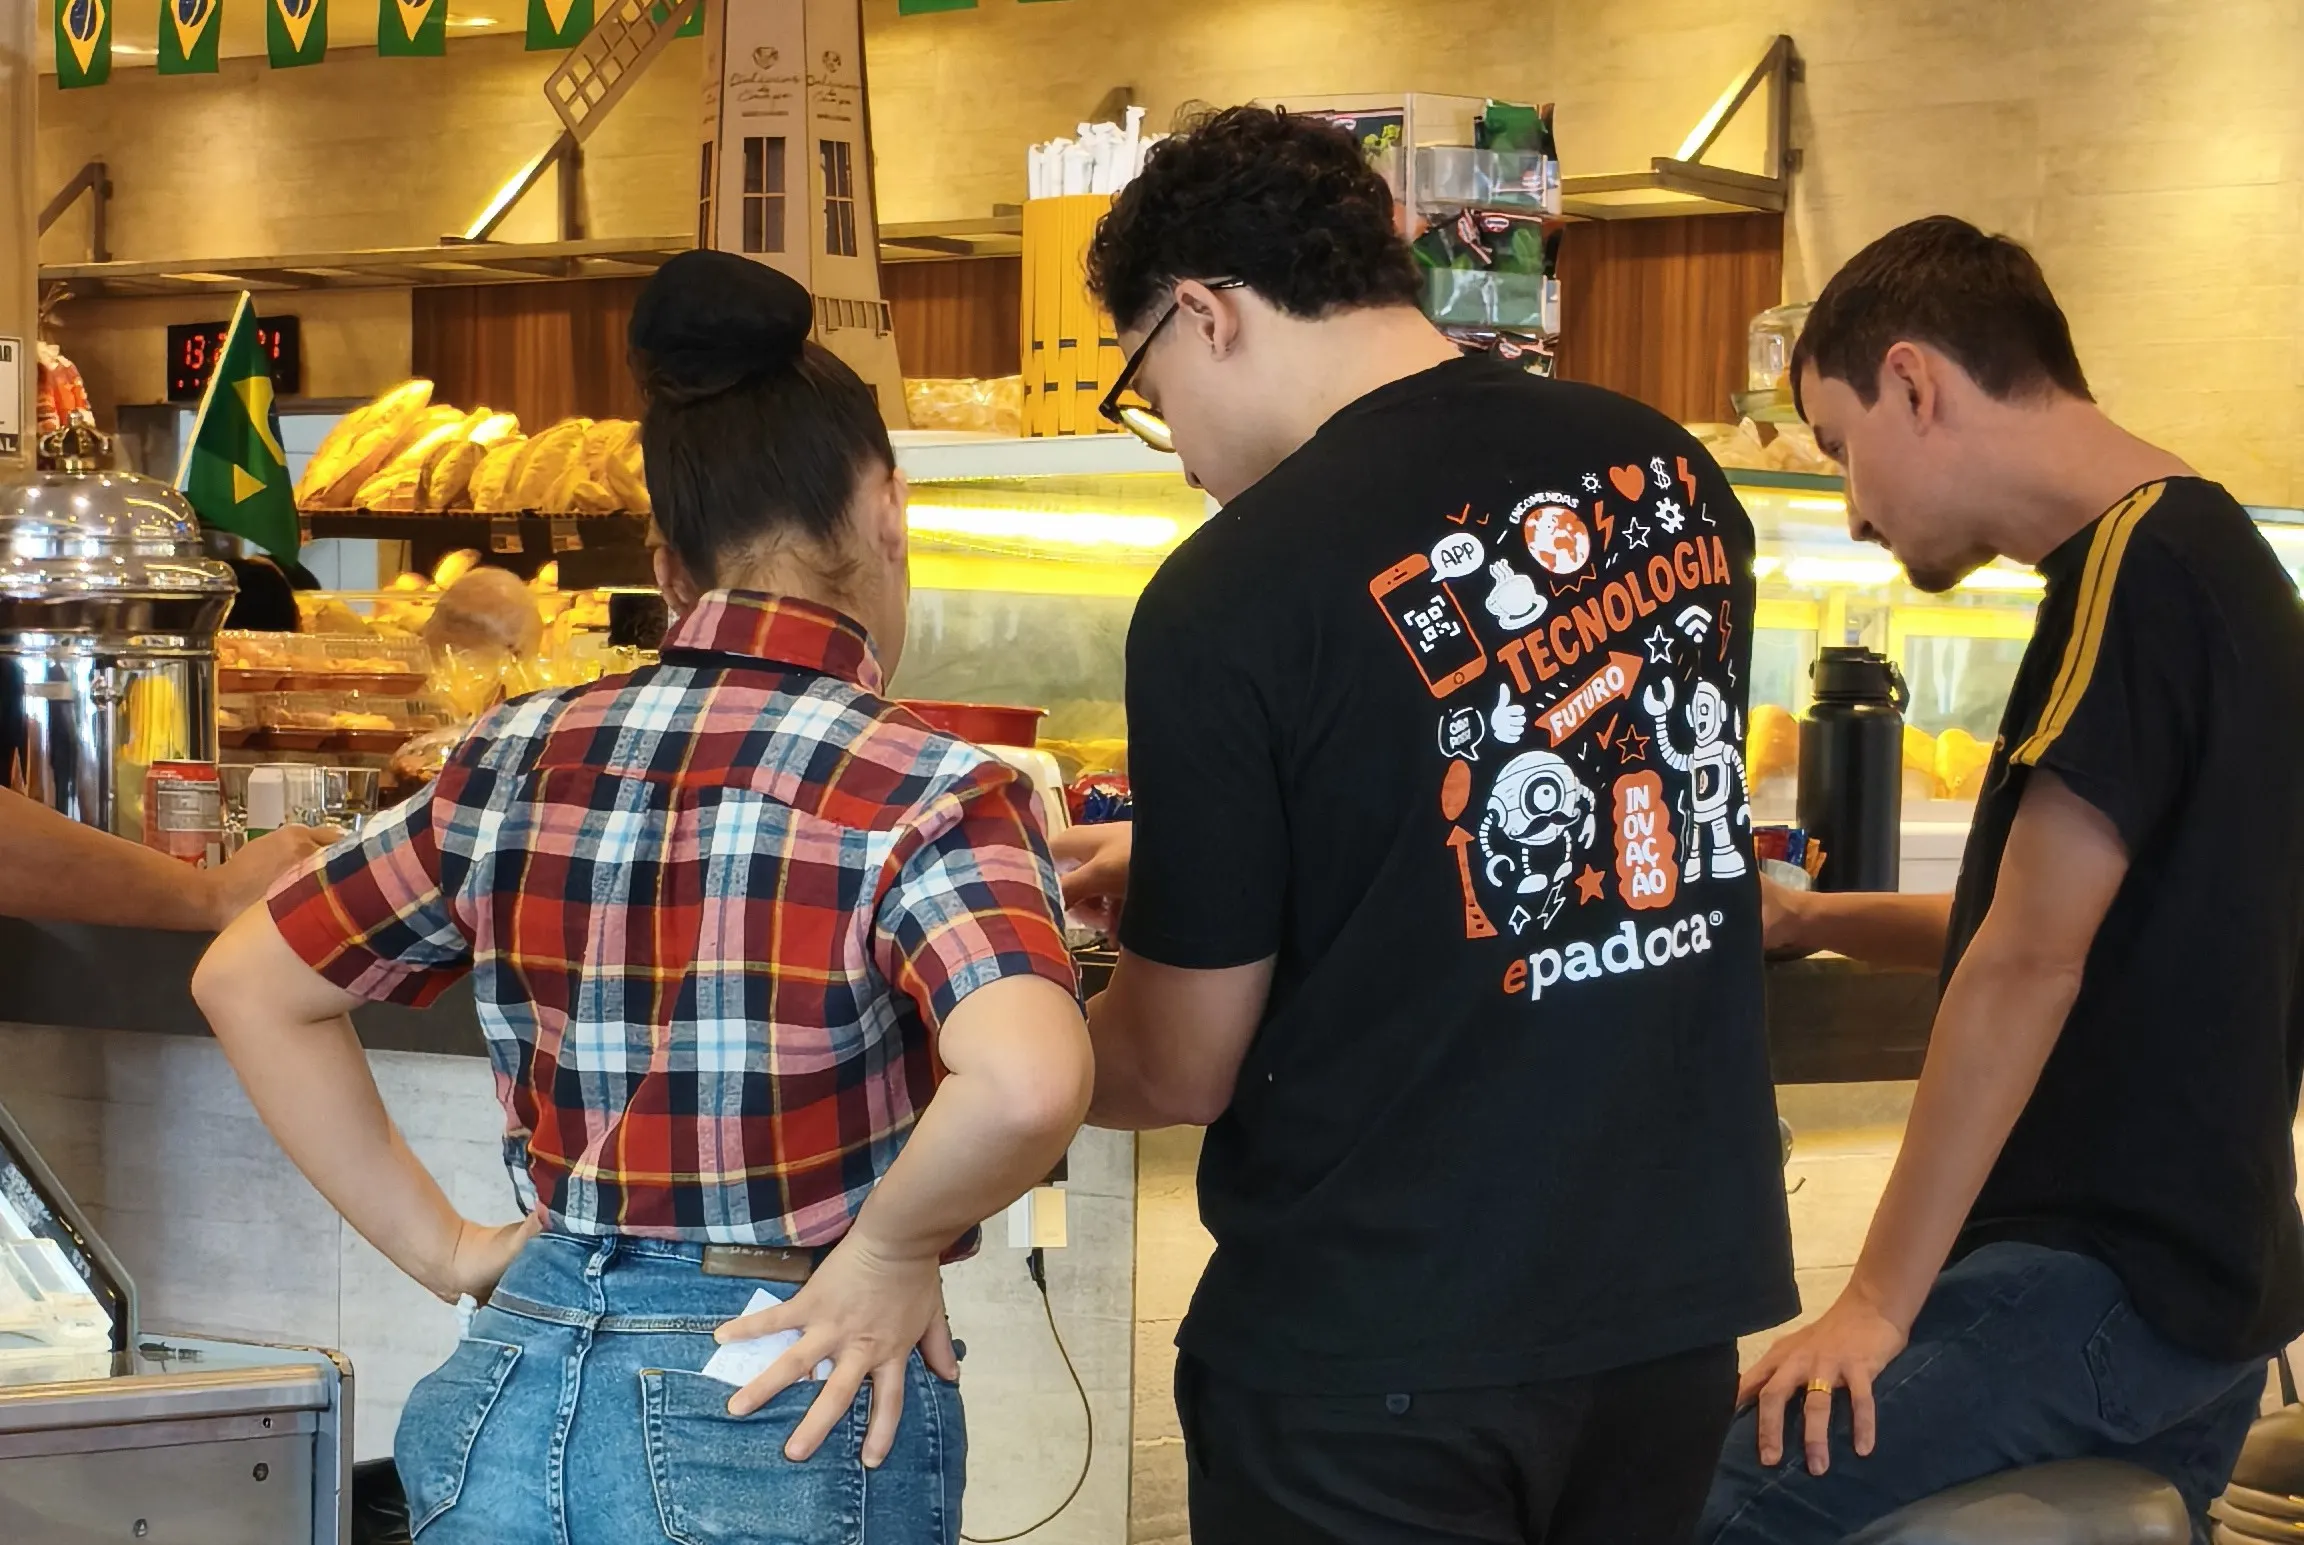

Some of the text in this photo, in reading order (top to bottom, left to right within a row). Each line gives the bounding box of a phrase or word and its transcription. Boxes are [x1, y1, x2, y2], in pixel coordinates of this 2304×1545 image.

[1441, 542, 1474, 568] APP
[1497, 535, 1731, 694] TECNOLOGIA
[1549, 666, 1625, 739] FUTURO
